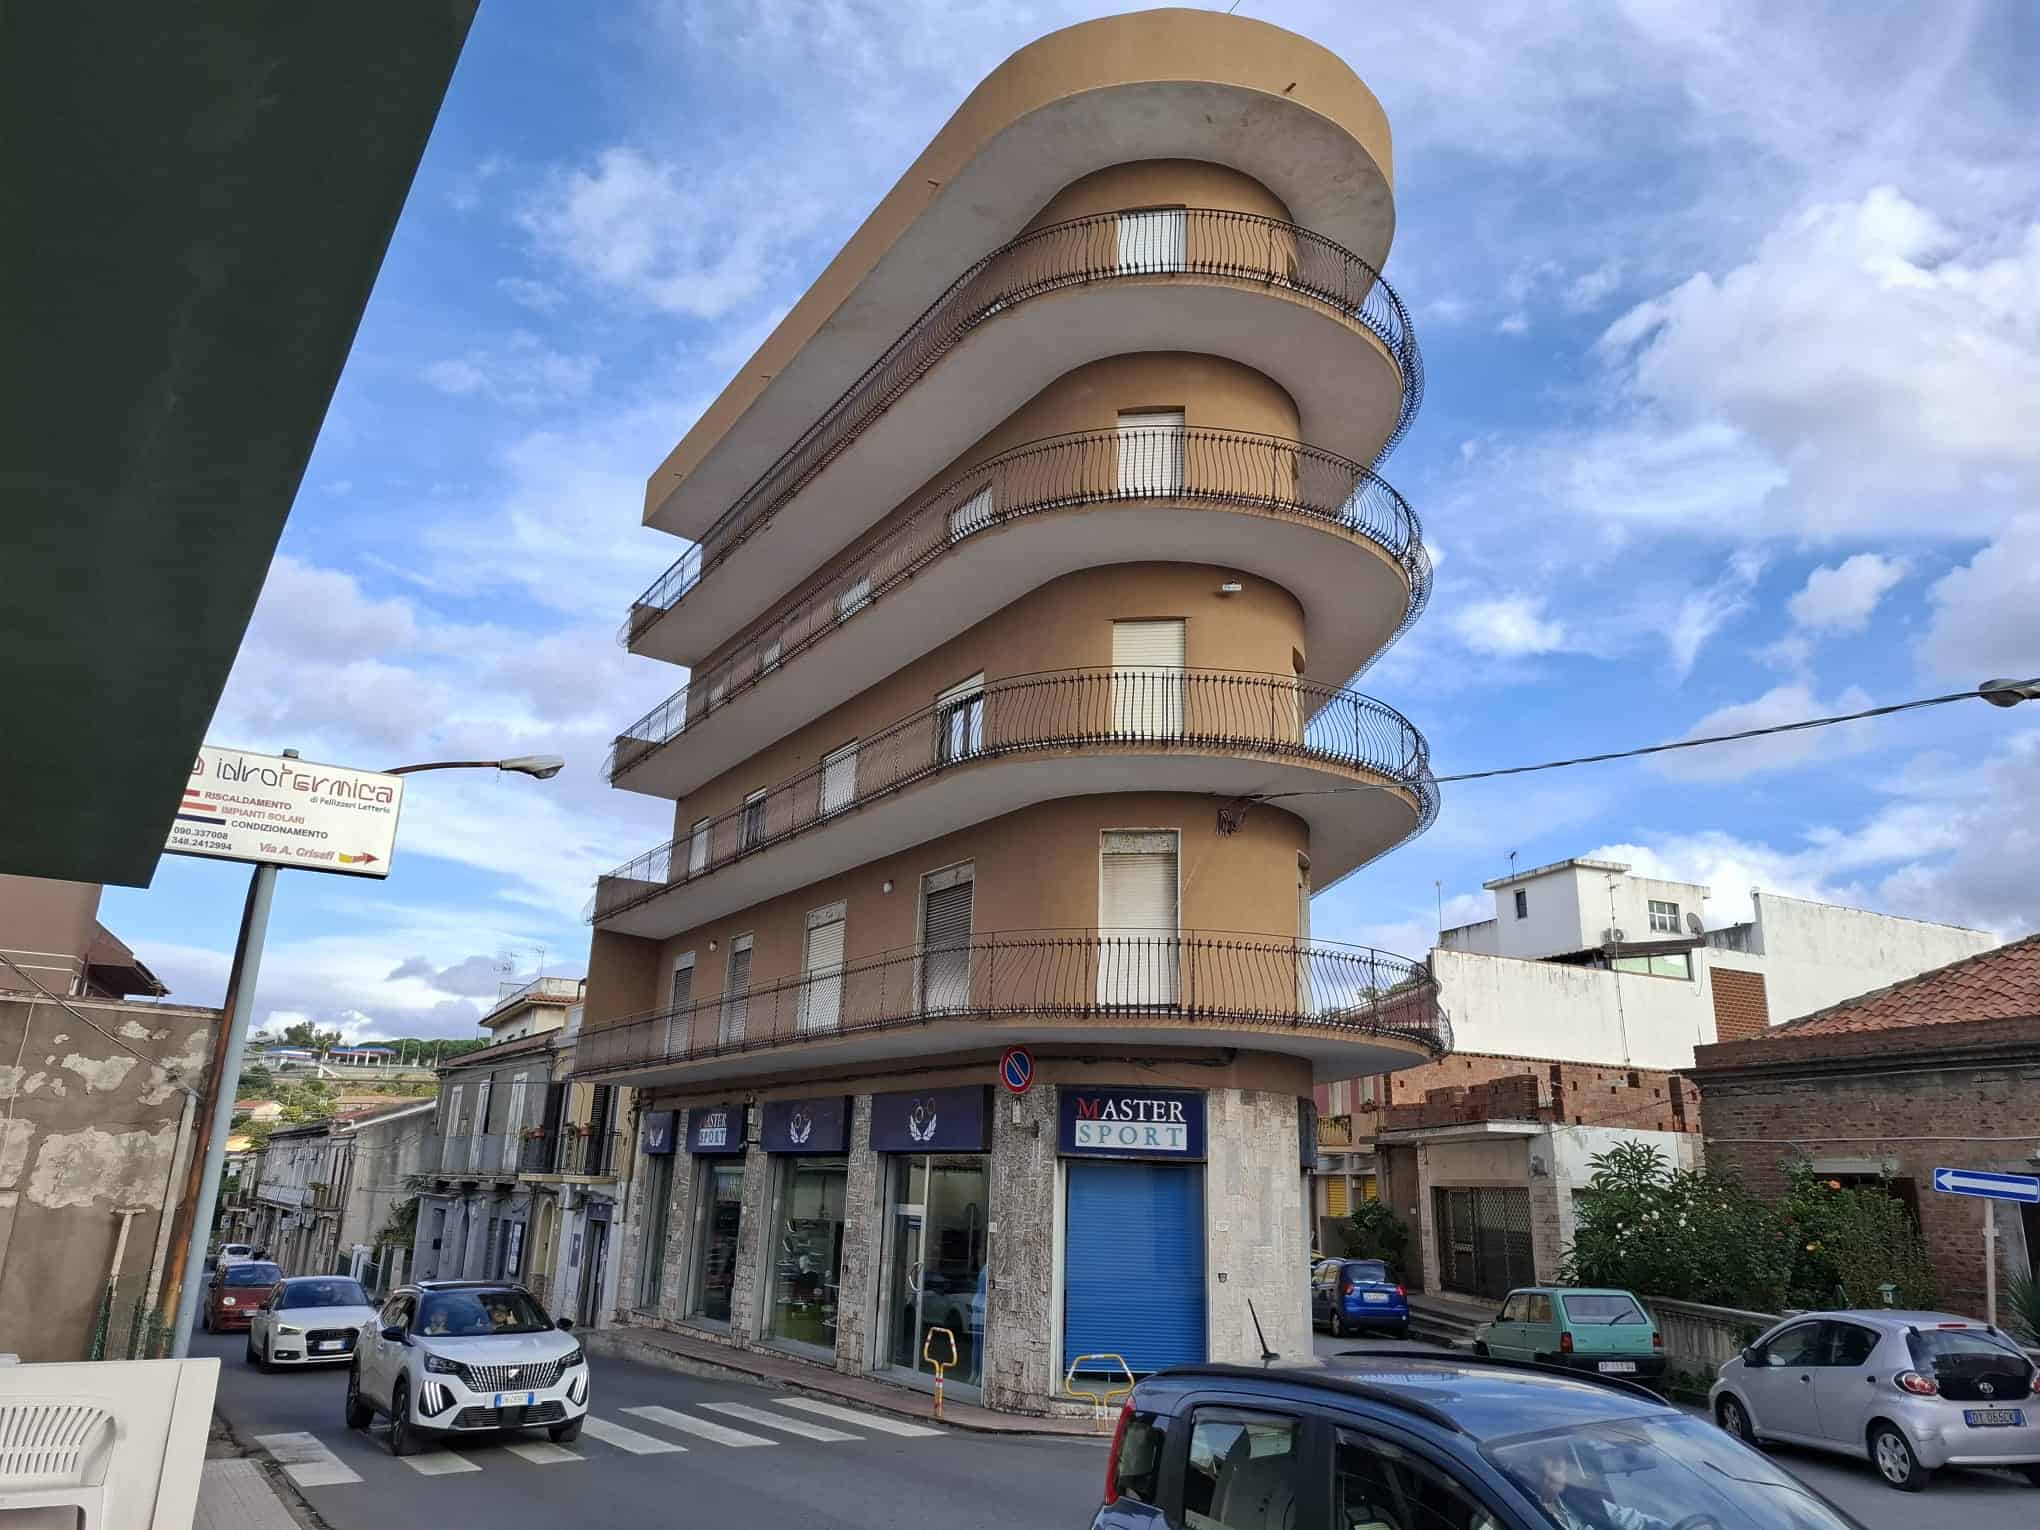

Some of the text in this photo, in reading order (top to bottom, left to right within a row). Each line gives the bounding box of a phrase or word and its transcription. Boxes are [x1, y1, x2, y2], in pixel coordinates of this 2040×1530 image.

[204, 791, 292, 810] RISCALDAMENTO
[222, 806, 305, 824] IMPIANTI SOLARI
[231, 820, 328, 839] CONDIZIONAMENTO
[259, 842, 277, 853] Via
[1077, 1097, 1187, 1122] MASTER
[700, 1129, 726, 1144] SPORT
[1079, 1124, 1184, 1147] SPORT
